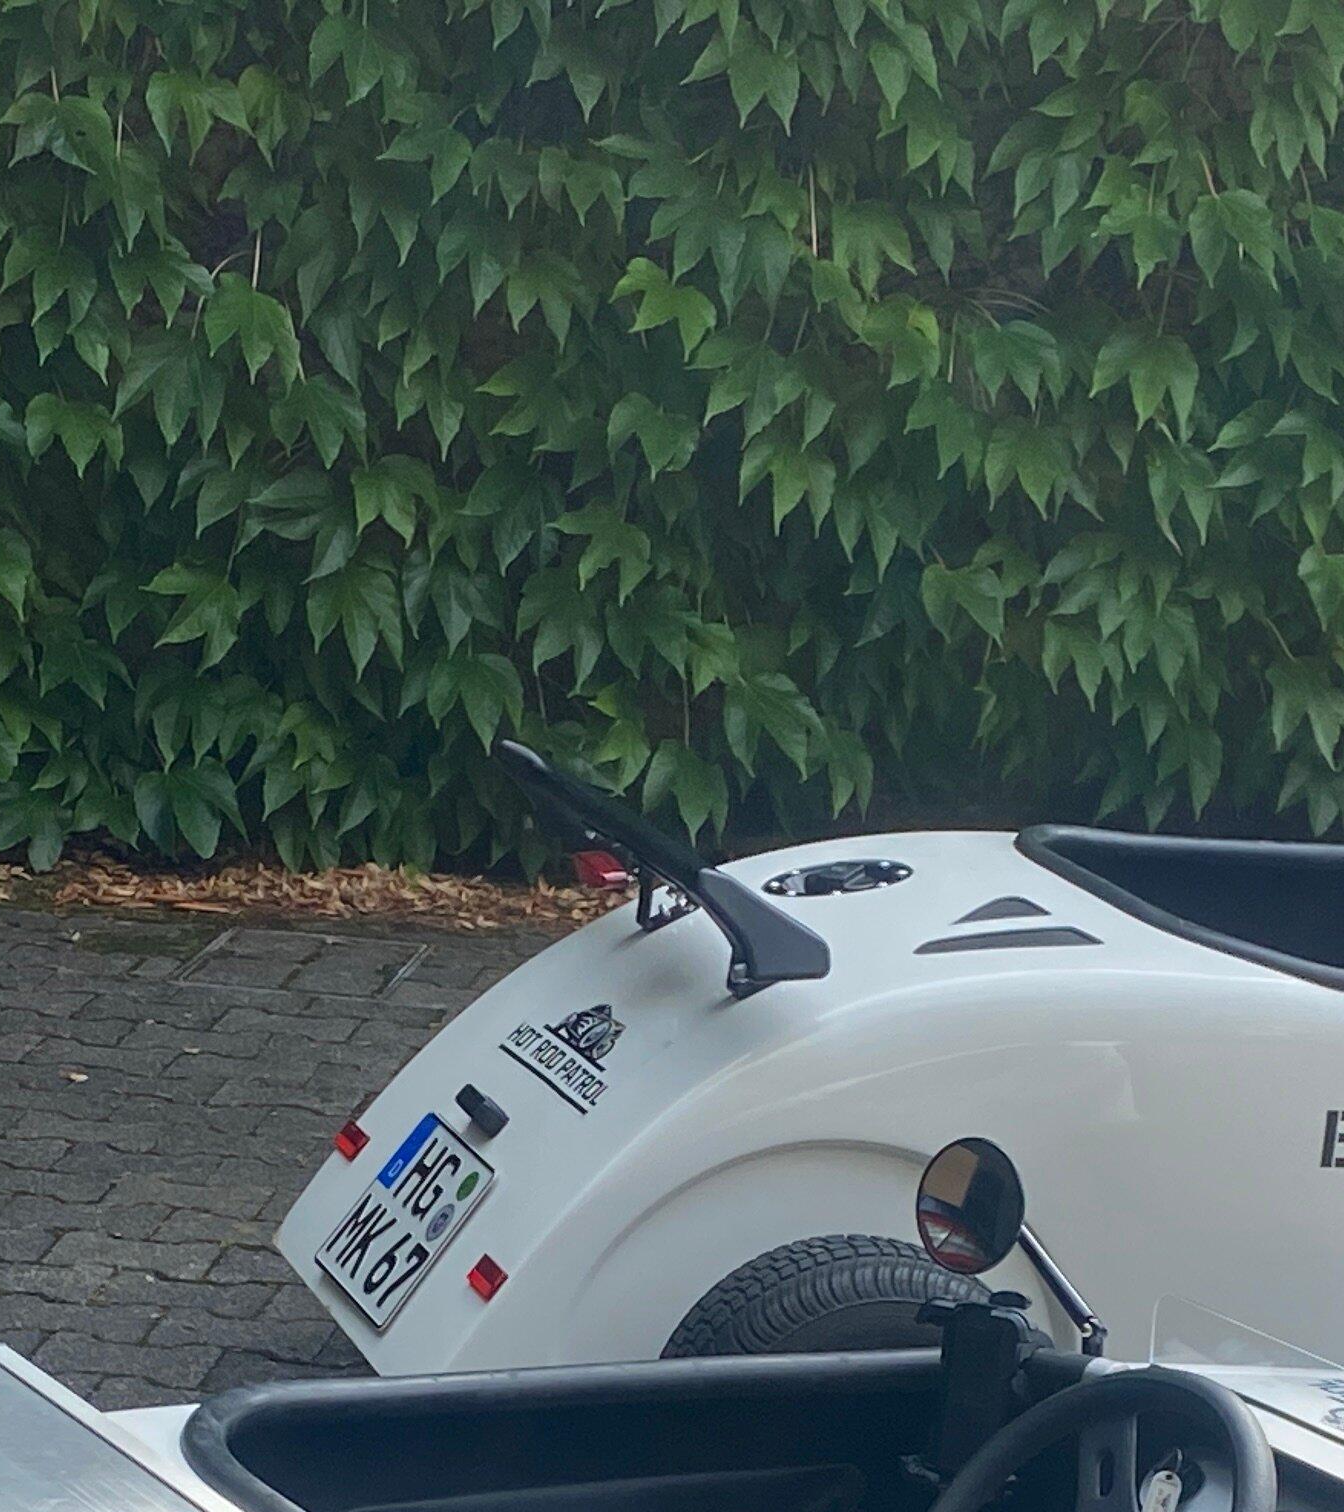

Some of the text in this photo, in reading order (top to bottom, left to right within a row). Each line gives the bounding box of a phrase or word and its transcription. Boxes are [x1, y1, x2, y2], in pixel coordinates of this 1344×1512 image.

[506, 1021, 608, 1106] HOT ROD PATROL
[392, 1137, 462, 1221] HG
[325, 1193, 431, 1308] MK 67
